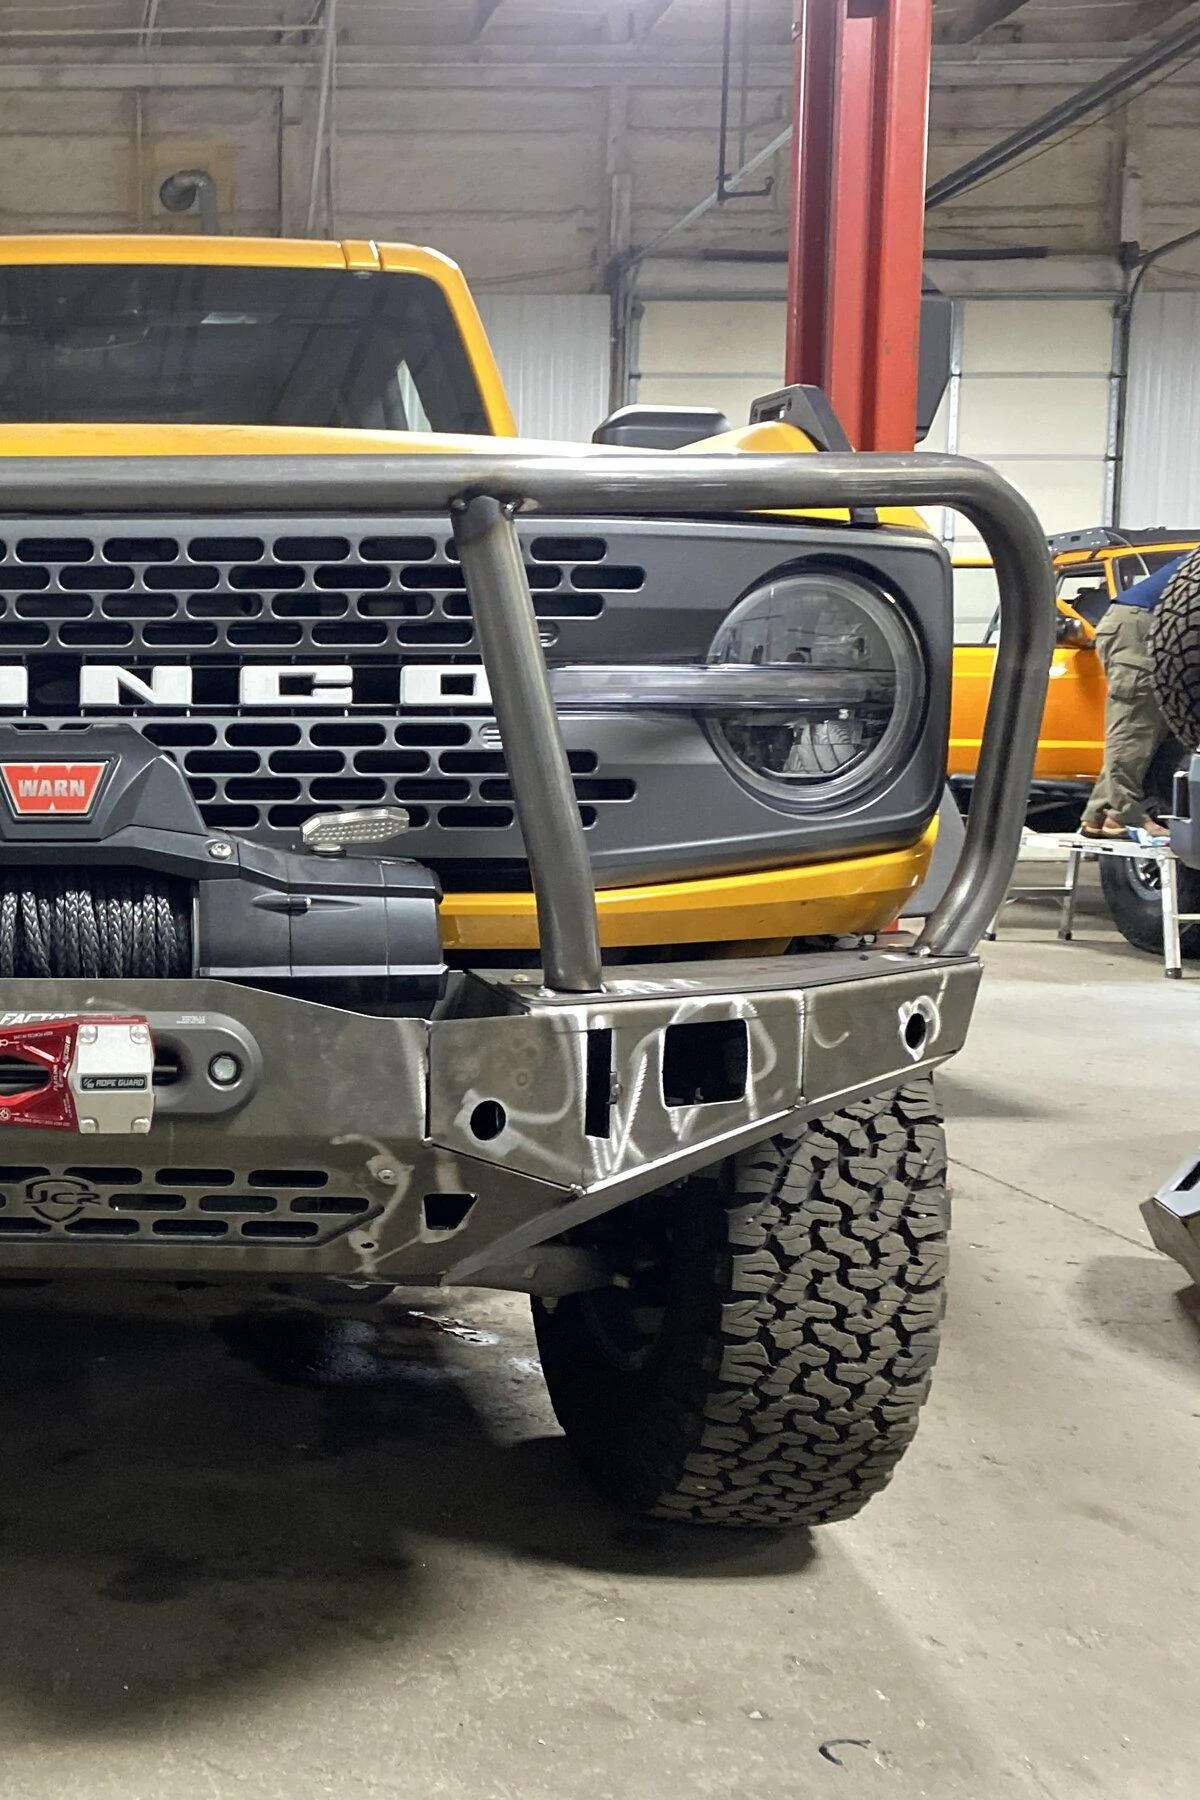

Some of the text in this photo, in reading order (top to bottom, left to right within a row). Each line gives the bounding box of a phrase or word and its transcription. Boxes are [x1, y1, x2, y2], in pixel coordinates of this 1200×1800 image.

[18, 779, 85, 797] WARN
[95, 1079, 144, 1087] ROPE GUARD
[23, 1190, 101, 1205] JCR
